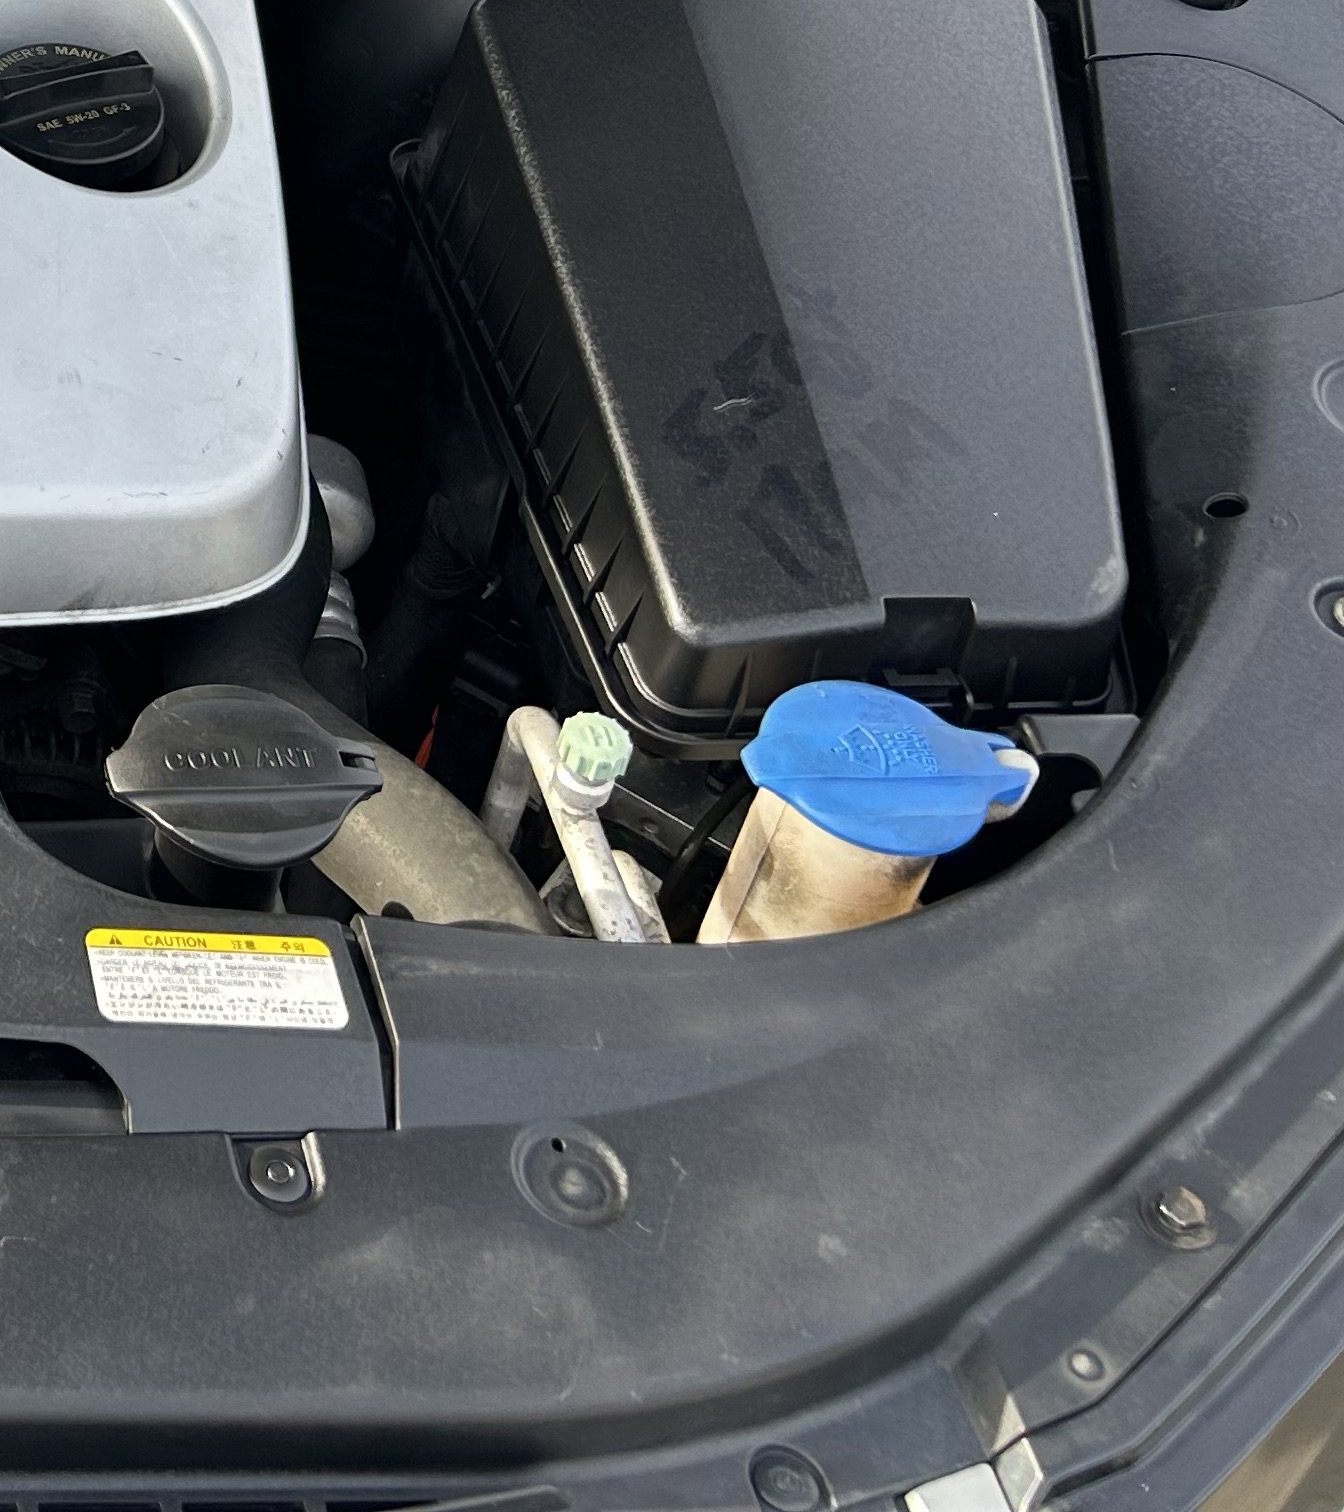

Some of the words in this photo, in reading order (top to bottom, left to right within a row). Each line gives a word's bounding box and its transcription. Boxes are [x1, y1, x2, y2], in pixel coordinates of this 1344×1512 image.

[54, 46, 105, 62] MANU
[36, 118, 63, 132] SAE
[65, 110, 100, 125] 5W-20
[102, 103, 131, 115] GF-3
[164, 747, 316, 772] COOLANT
[143, 934, 208, 949] CAUTION
[280, 941, 305, 954] 주의
